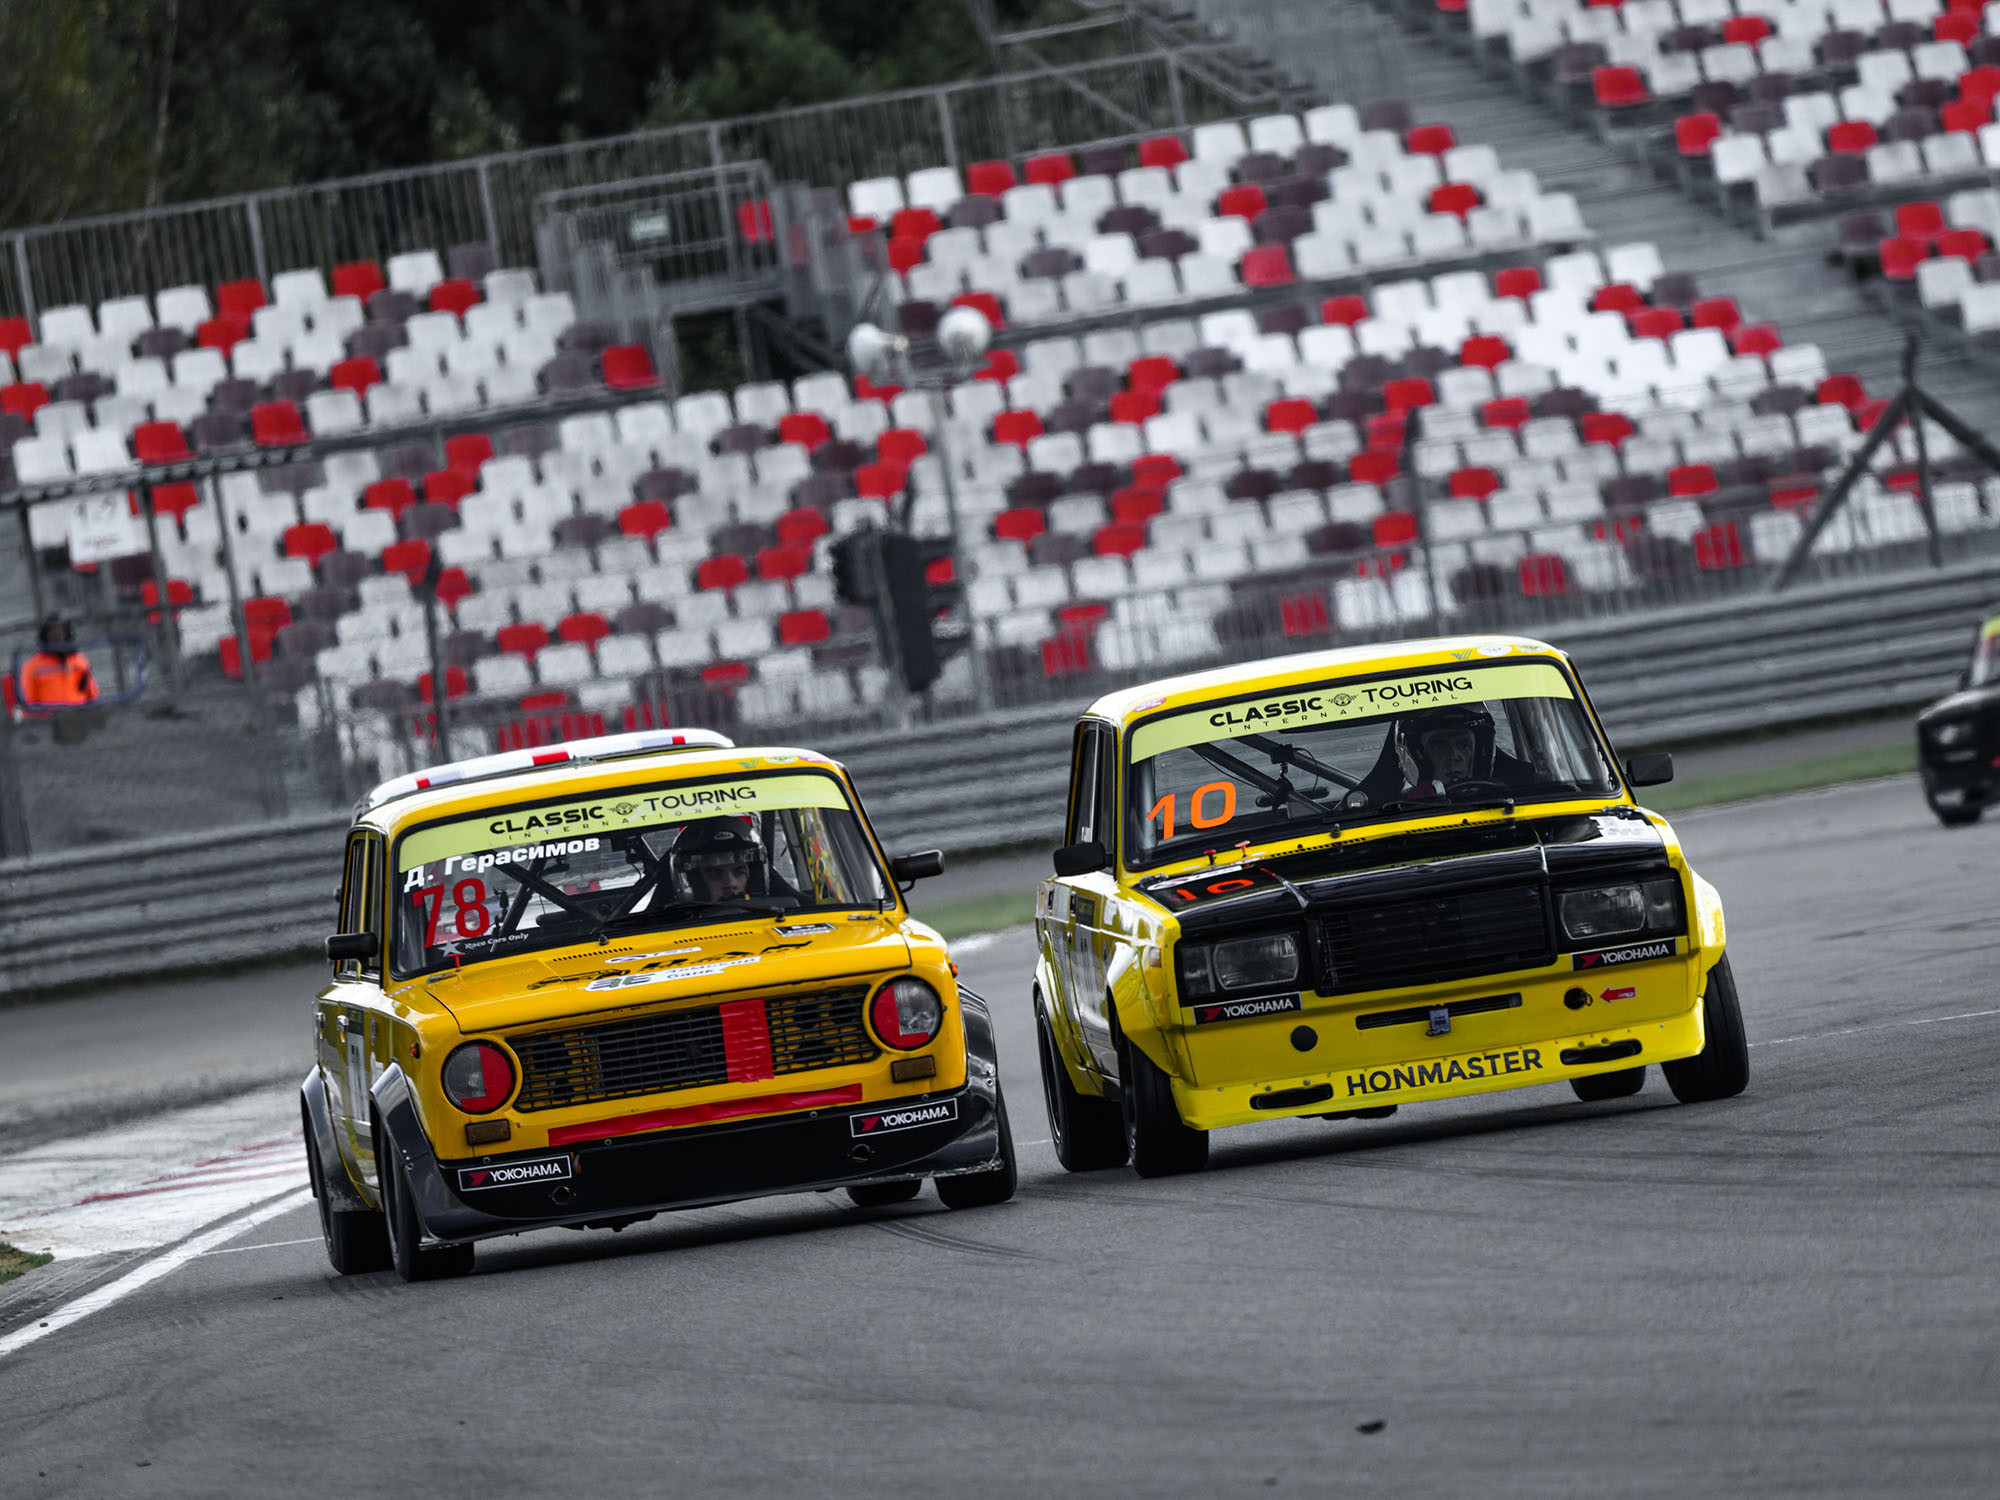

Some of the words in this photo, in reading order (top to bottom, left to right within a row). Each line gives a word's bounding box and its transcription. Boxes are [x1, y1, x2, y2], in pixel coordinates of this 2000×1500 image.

[1209, 696, 1324, 728] CLASSIC
[1362, 677, 1473, 703] TOURING
[1229, 694, 1458, 733] INTERNATIONAL
[489, 805, 605, 835] CLASSIC
[643, 786, 757, 812] TOURING
[508, 803, 741, 840] INTERNATIONAL
[1146, 781, 1237, 840] 10
[403, 865, 435, 893] Д.
[445, 837, 600, 876] Герасимов
[412, 878, 490, 949] 78
[464, 939, 486, 950] Race
[487, 935, 508, 945] Cars
[508, 932, 529, 942] Only
[1601, 944, 1669, 964] YOKOHAMA
[1223, 998, 1293, 1017] YOKOHAMA
[1346, 1048, 1544, 1097] HONMASTER
[881, 1106, 949, 1127] YOKOHAMA
[490, 1162, 562, 1182] YOKOHAMA
